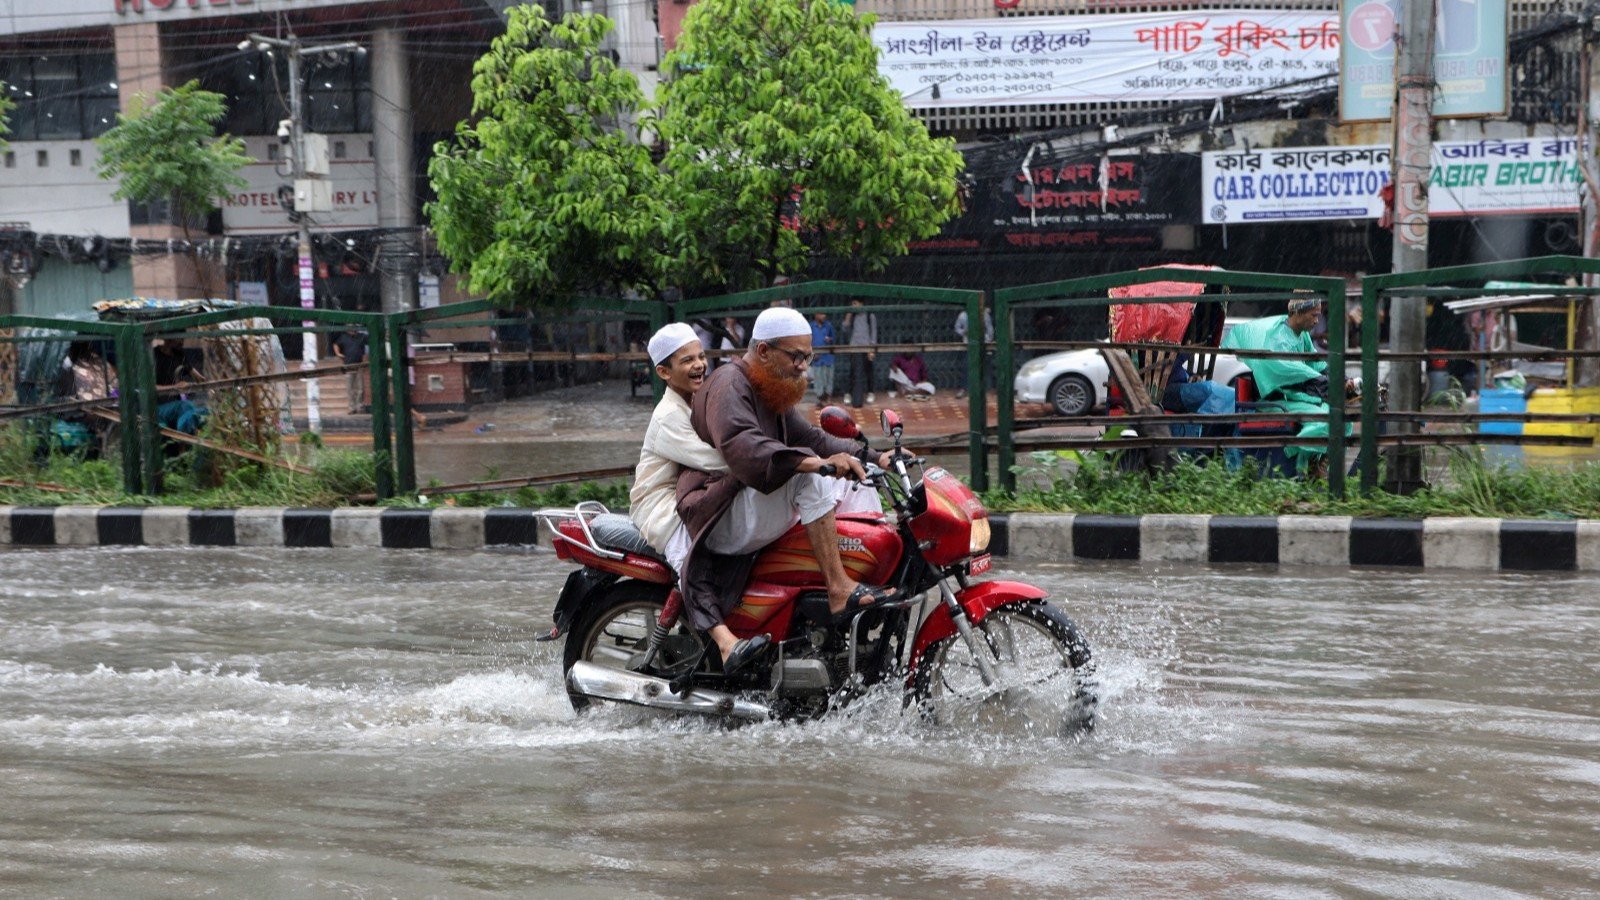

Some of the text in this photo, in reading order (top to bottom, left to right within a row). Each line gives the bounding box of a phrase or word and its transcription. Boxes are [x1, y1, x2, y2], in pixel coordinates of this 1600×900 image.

[1134, 18, 1208, 53] পার্টি
[1213, 20, 1290, 57] বুকিং
[1441, 139, 1531, 158] আবির
[1214, 149, 1390, 172] কার কালেকশন
[1429, 164, 1488, 187] ABIR
[1214, 176, 1256, 201] CAR
[838, 537, 862, 545] ERO
[838, 544, 866, 553] NDA
